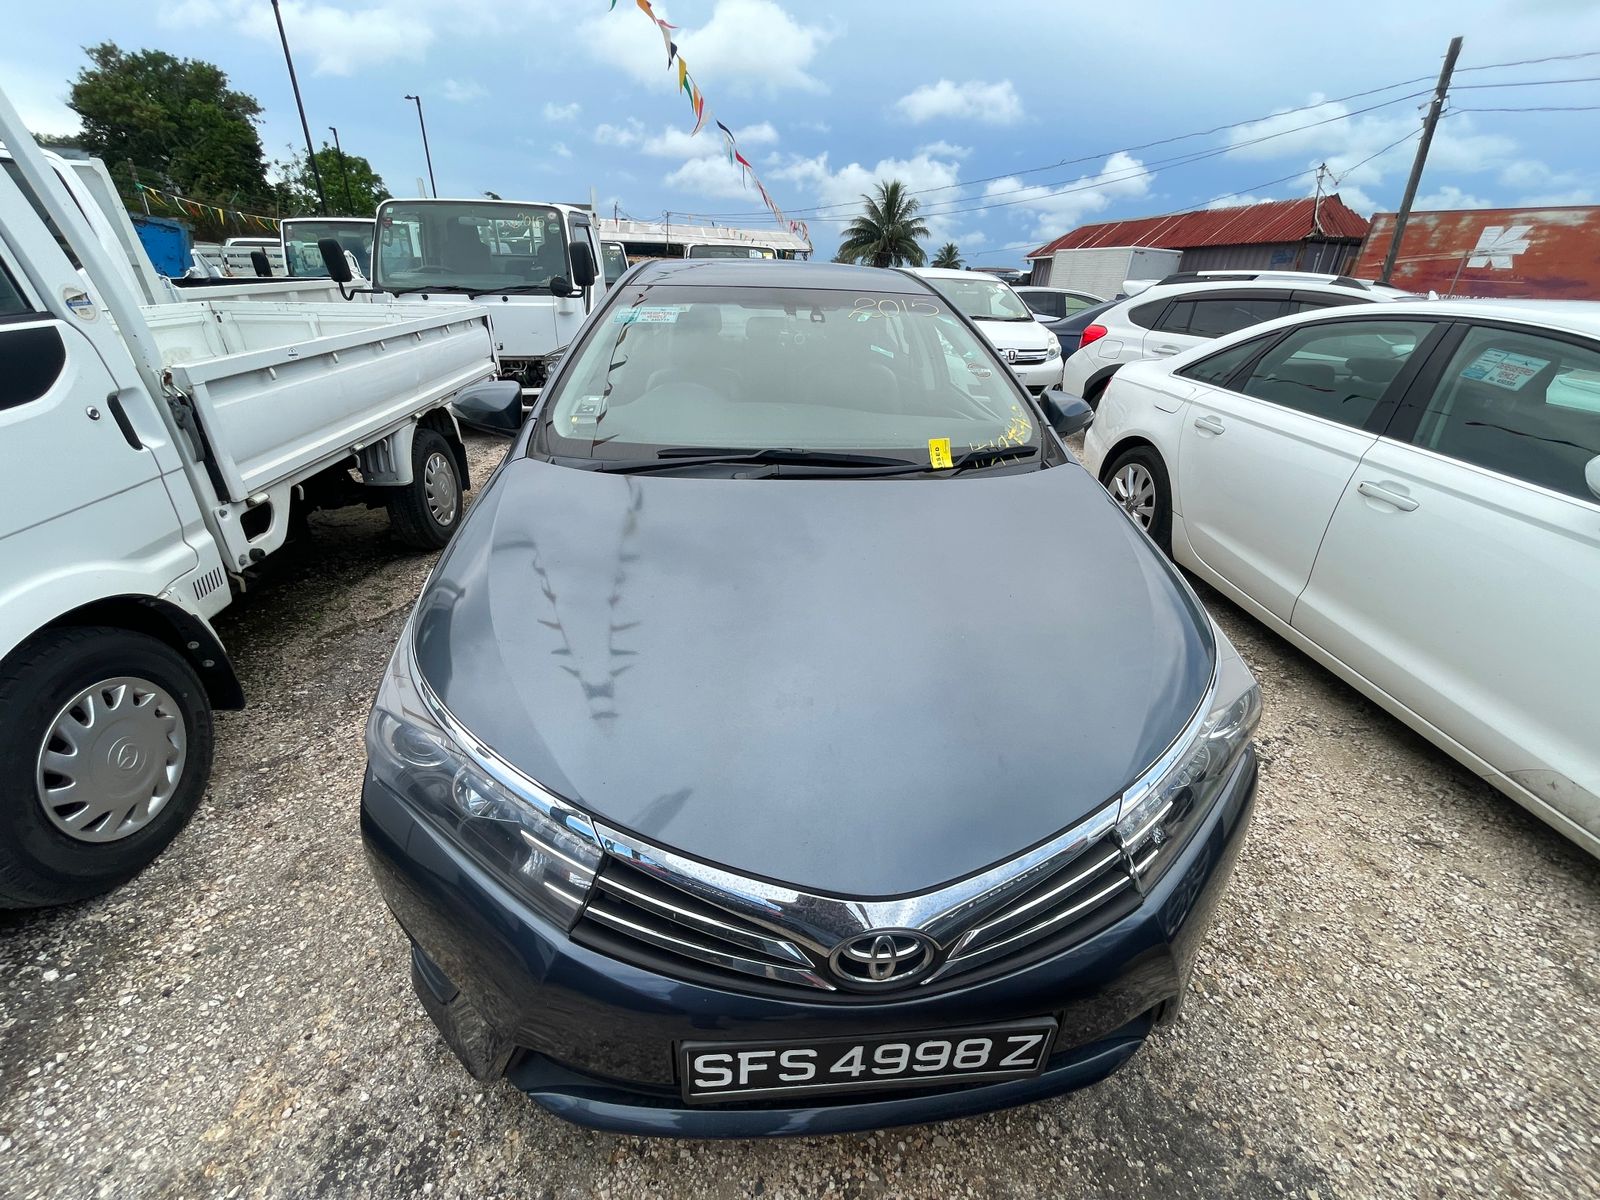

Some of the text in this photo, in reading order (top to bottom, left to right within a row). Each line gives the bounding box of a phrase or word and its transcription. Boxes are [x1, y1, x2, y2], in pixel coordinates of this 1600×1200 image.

[848, 297, 939, 319] 2015
[694, 1034, 1044, 1088] SFS 4998 Z
